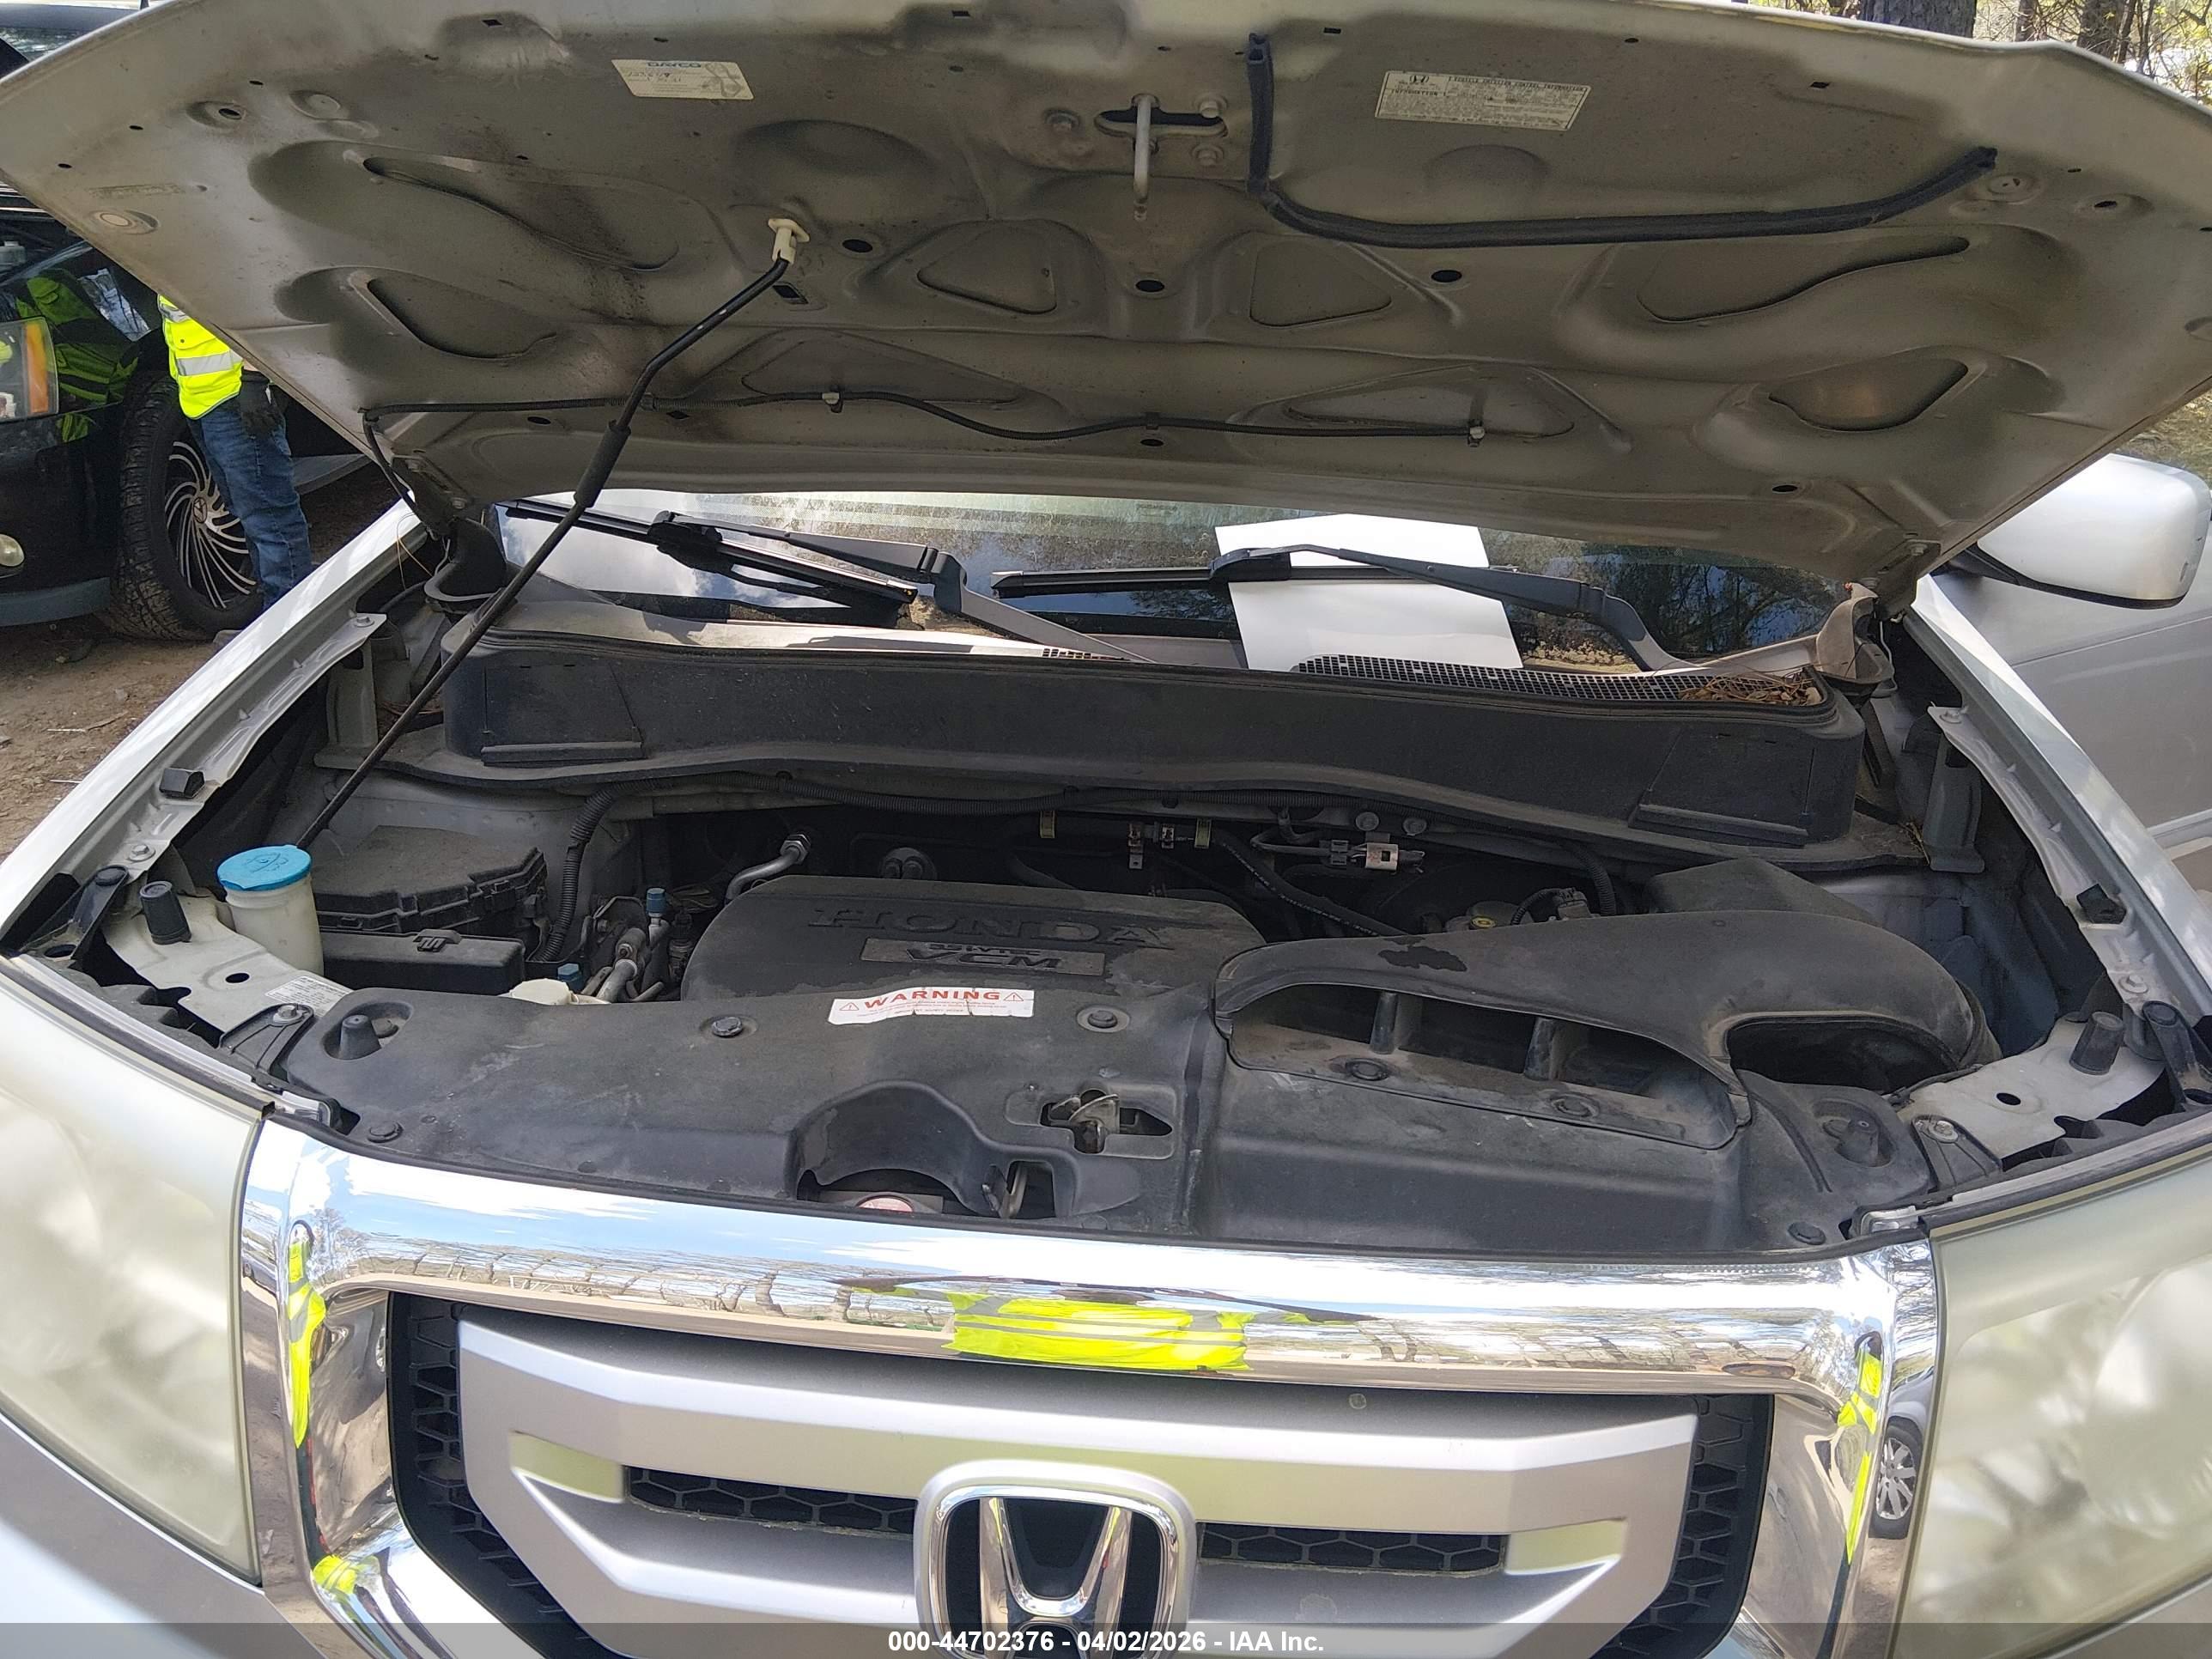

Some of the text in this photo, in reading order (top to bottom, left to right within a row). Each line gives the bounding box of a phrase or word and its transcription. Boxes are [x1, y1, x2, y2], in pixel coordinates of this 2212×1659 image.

[807, 908, 1176, 951] HONDA
[906, 948, 1061, 969] VCM
[864, 989, 1000, 1009] WARNING
